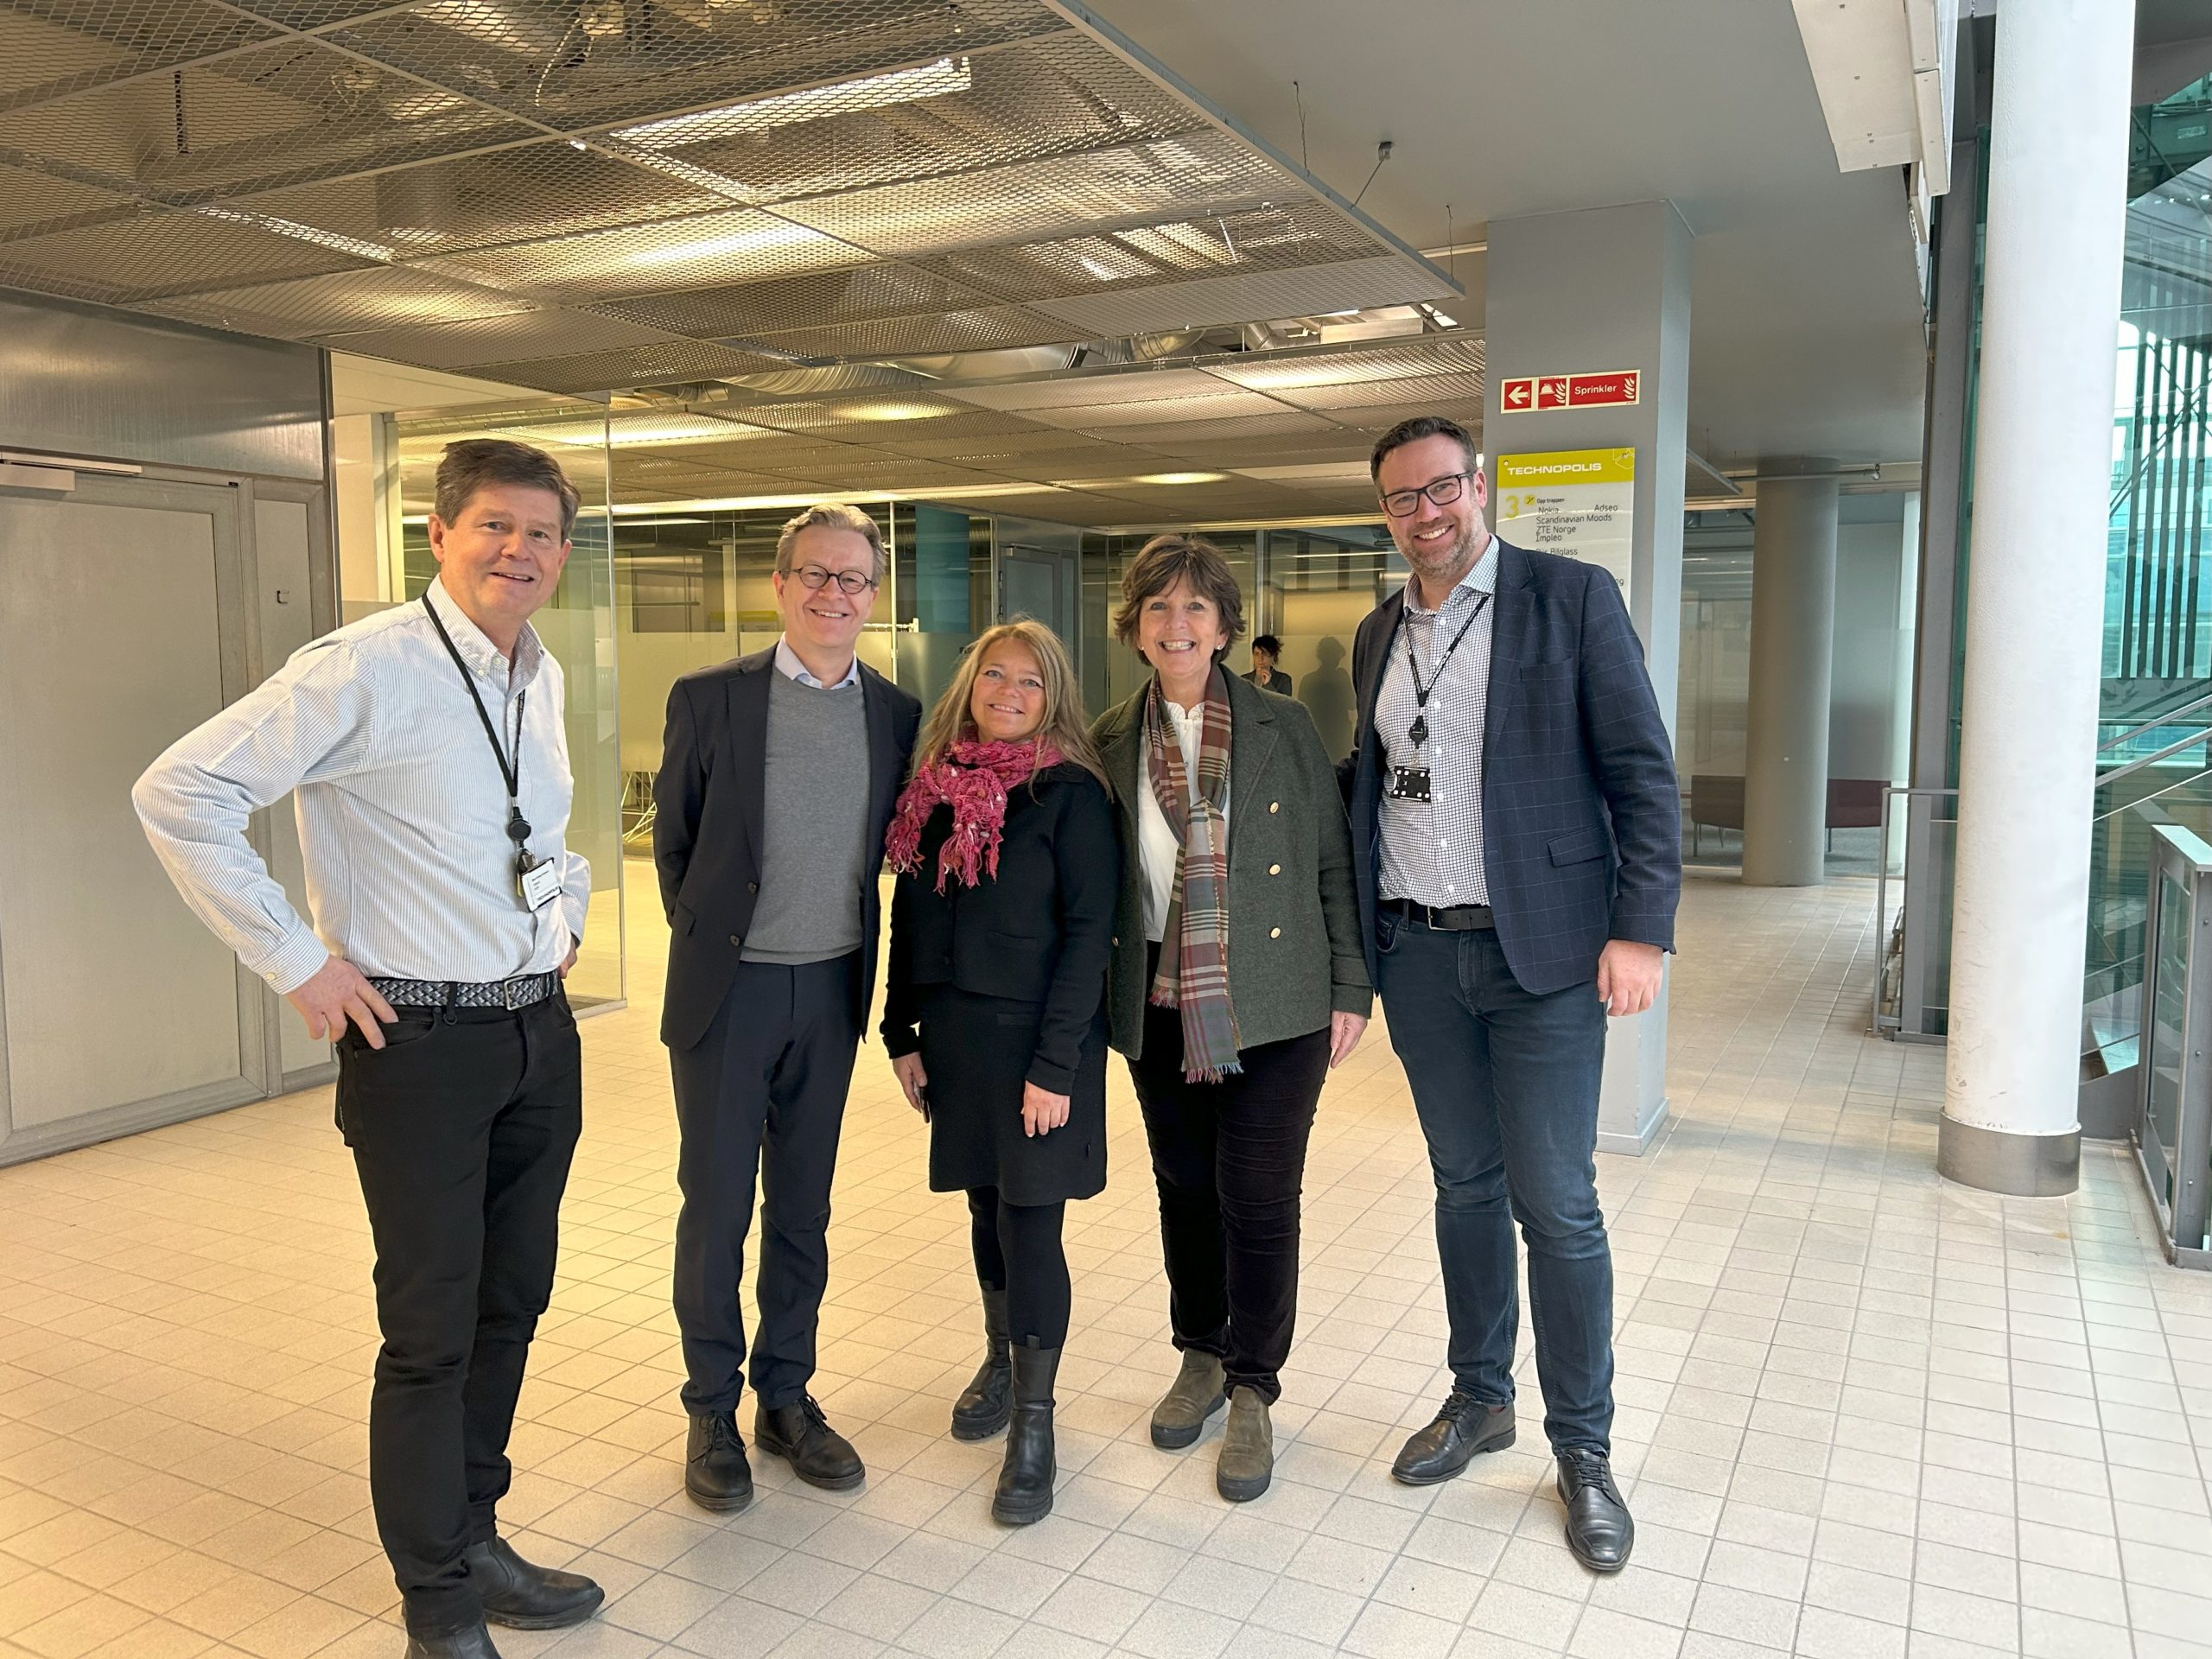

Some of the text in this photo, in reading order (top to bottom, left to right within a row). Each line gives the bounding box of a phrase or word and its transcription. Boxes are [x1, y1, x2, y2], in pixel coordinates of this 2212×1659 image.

[1574, 385, 1617, 396] Sprinkler
[1507, 462, 1602, 476] TECHNOPOLIS
[1505, 495, 1520, 519] 3
[1536, 513, 1612, 524] Scandinavian Moods
[1536, 525, 1551, 534] ZTE
[1535, 532, 1562, 543] Impleo
